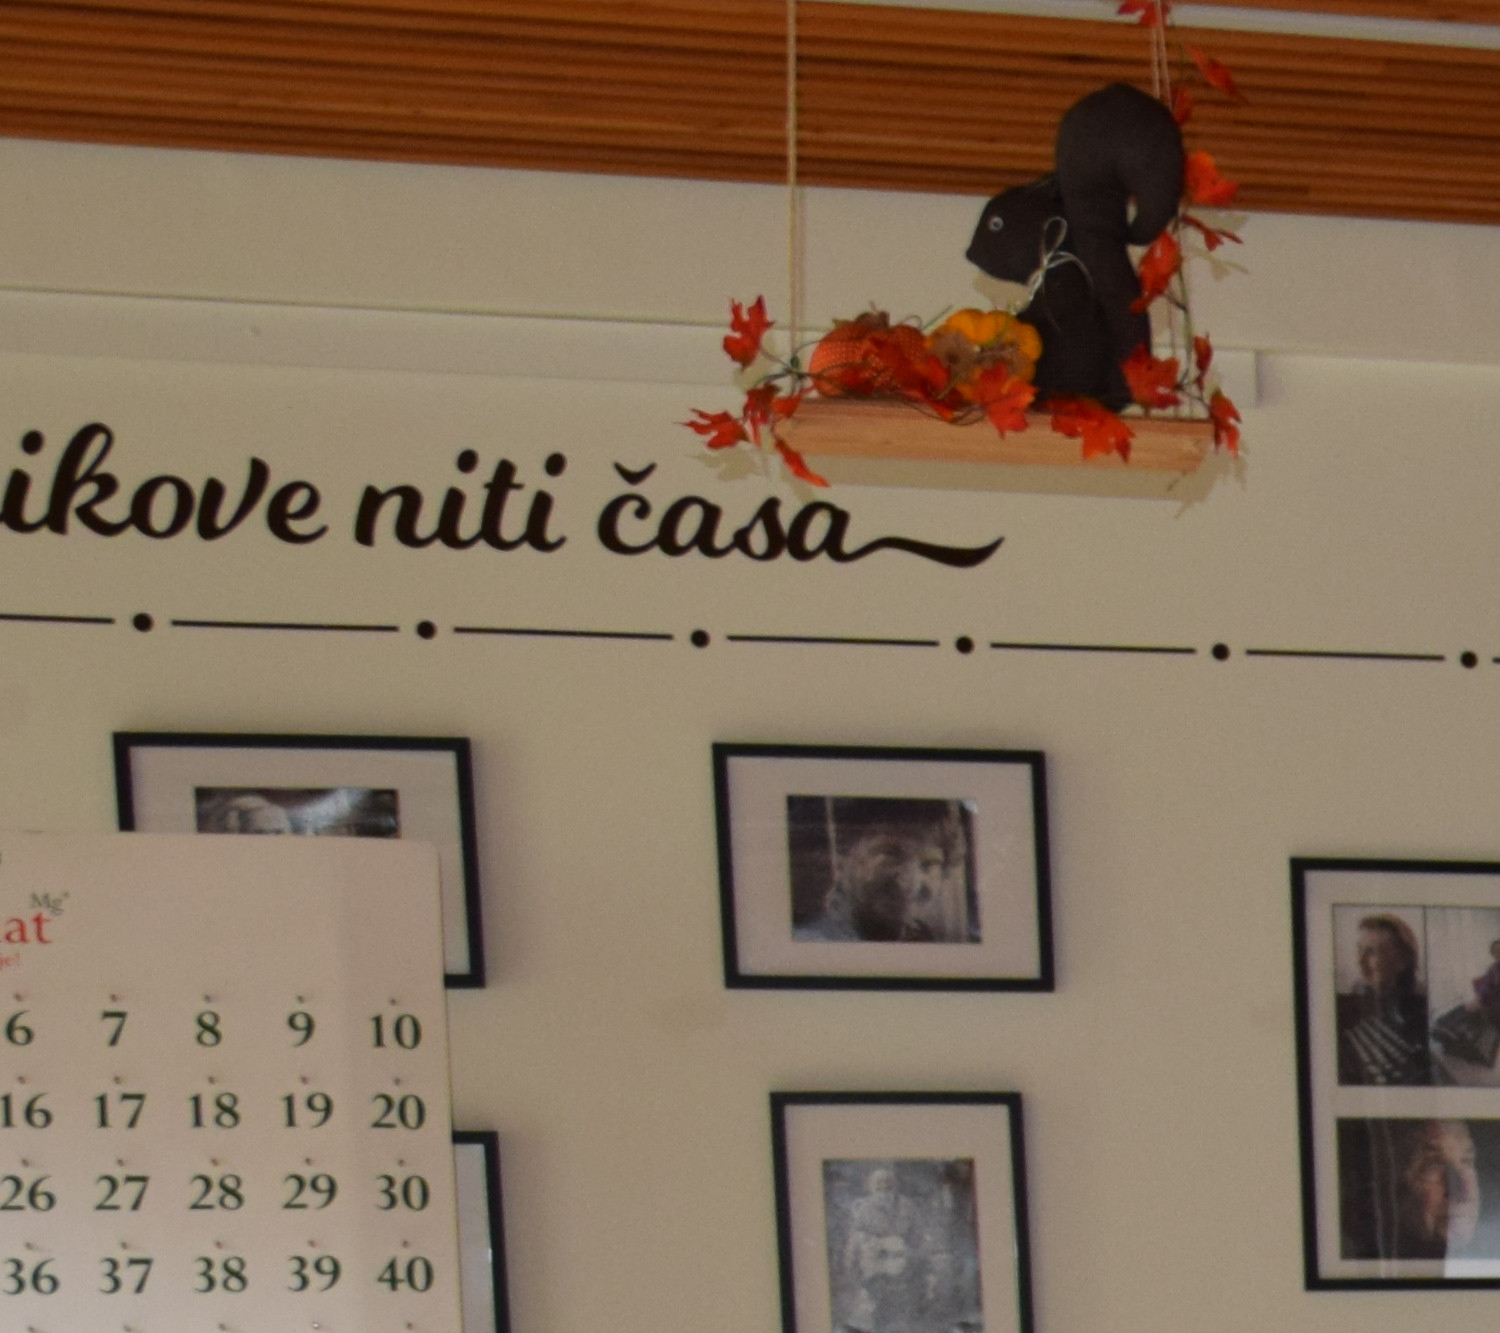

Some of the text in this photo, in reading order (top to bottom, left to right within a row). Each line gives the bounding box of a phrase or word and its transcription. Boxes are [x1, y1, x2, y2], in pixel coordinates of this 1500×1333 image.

[0, 422, 1005, 568] ikove niti časa
[0, 912, 53, 944] at
[4, 1010, 422, 1050] 6 7 8 9 10
[0, 1092, 426, 1131] 16 17 18 19 20
[0, 1173, 430, 1212] 26 27 28 29 30
[4, 1254, 435, 1296] 36 37 38 39 40
